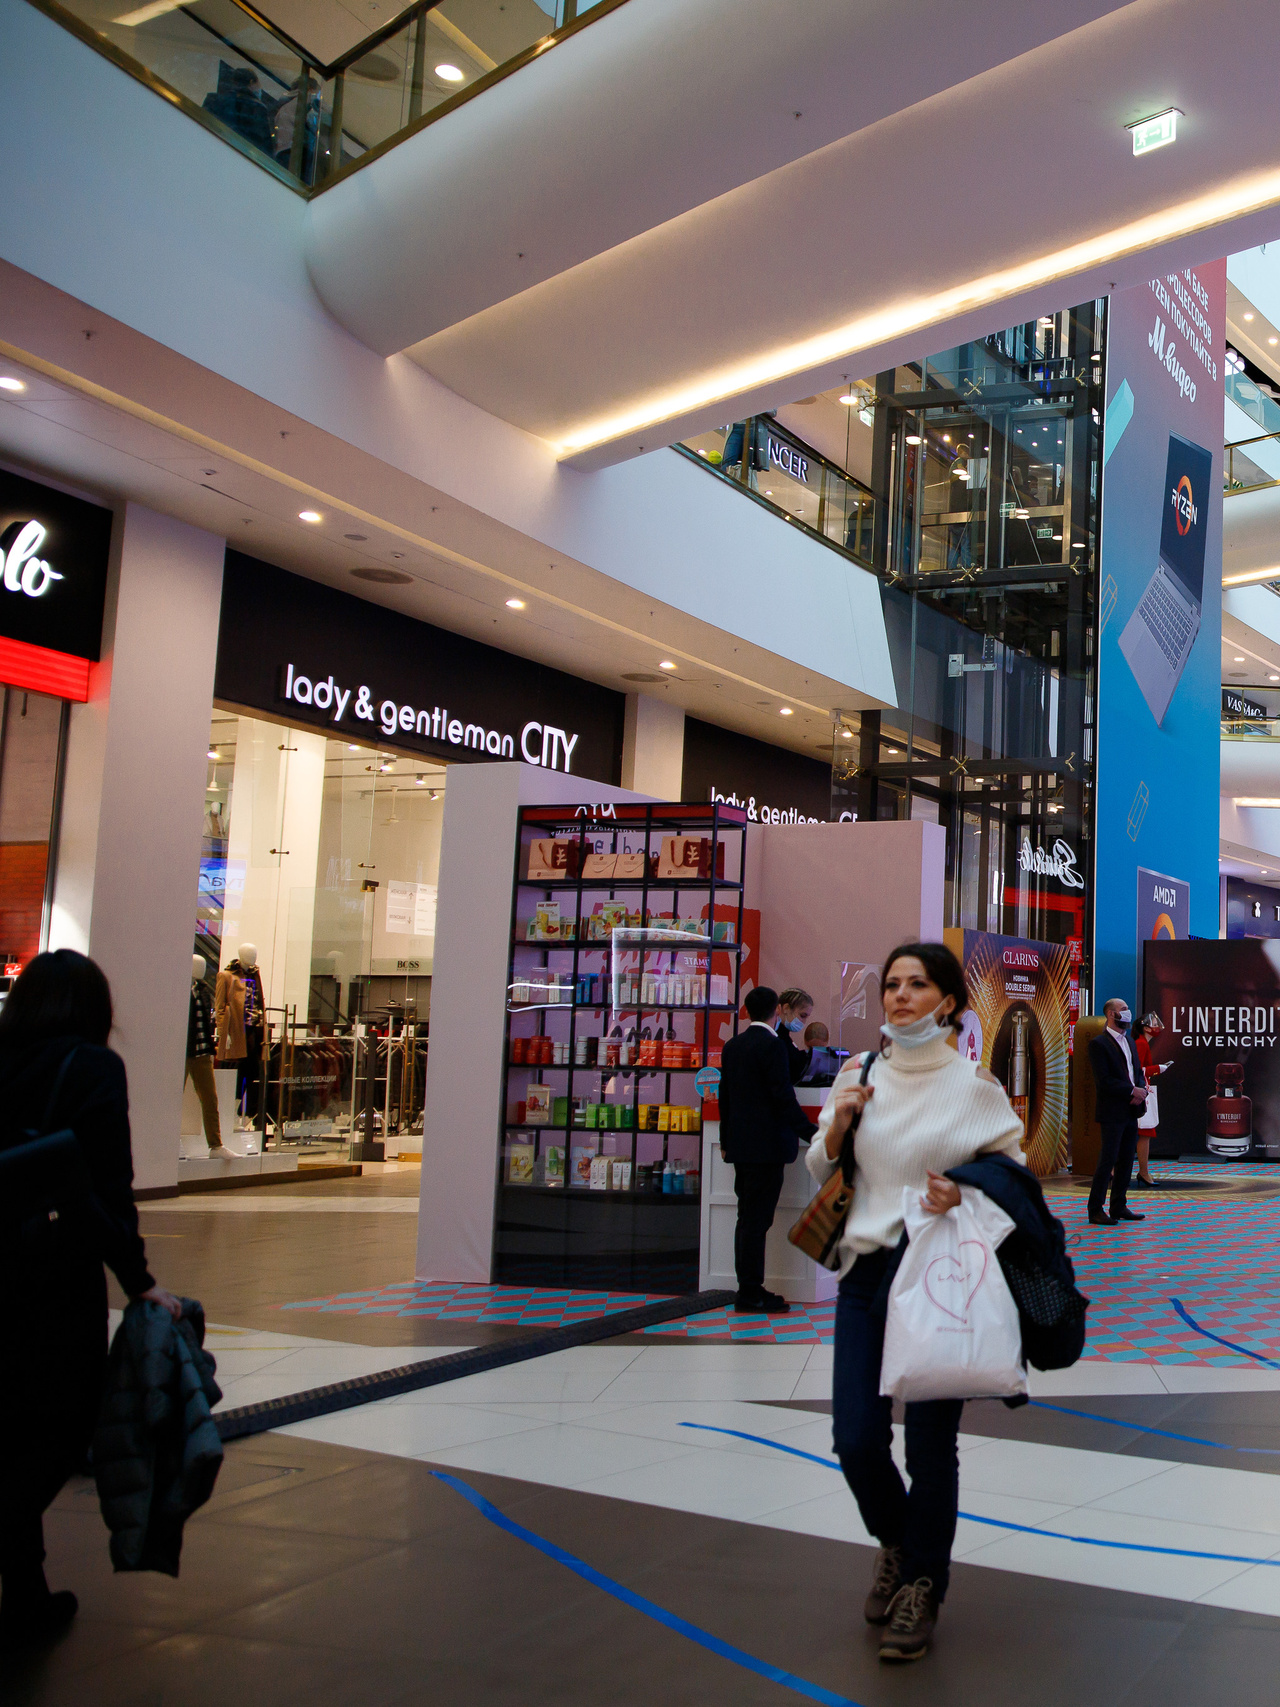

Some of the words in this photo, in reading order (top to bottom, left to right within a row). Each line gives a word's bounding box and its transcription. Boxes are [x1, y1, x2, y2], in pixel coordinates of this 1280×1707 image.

[1192, 273, 1209, 312] БАЗЕ
[1171, 300, 1212, 375] ПОКУПАЙТЕ
[1212, 362, 1217, 381] В
[1171, 488, 1198, 526] RYZEN
[0, 519, 65, 597] lo
[285, 663, 351, 721] lady
[354, 685, 374, 721] &
[380, 700, 514, 759] gentleman
[520, 721, 579, 773] CITY
[747, 796, 758, 822] &
[1153, 885, 1172, 906] AMD
[1003, 950, 1039, 968] CLARINS
[1005, 982, 1022, 991] DOUBLE
[1022, 984, 1036, 992] SERUM
[1182, 1035, 1278, 1047] GIVENCHY
